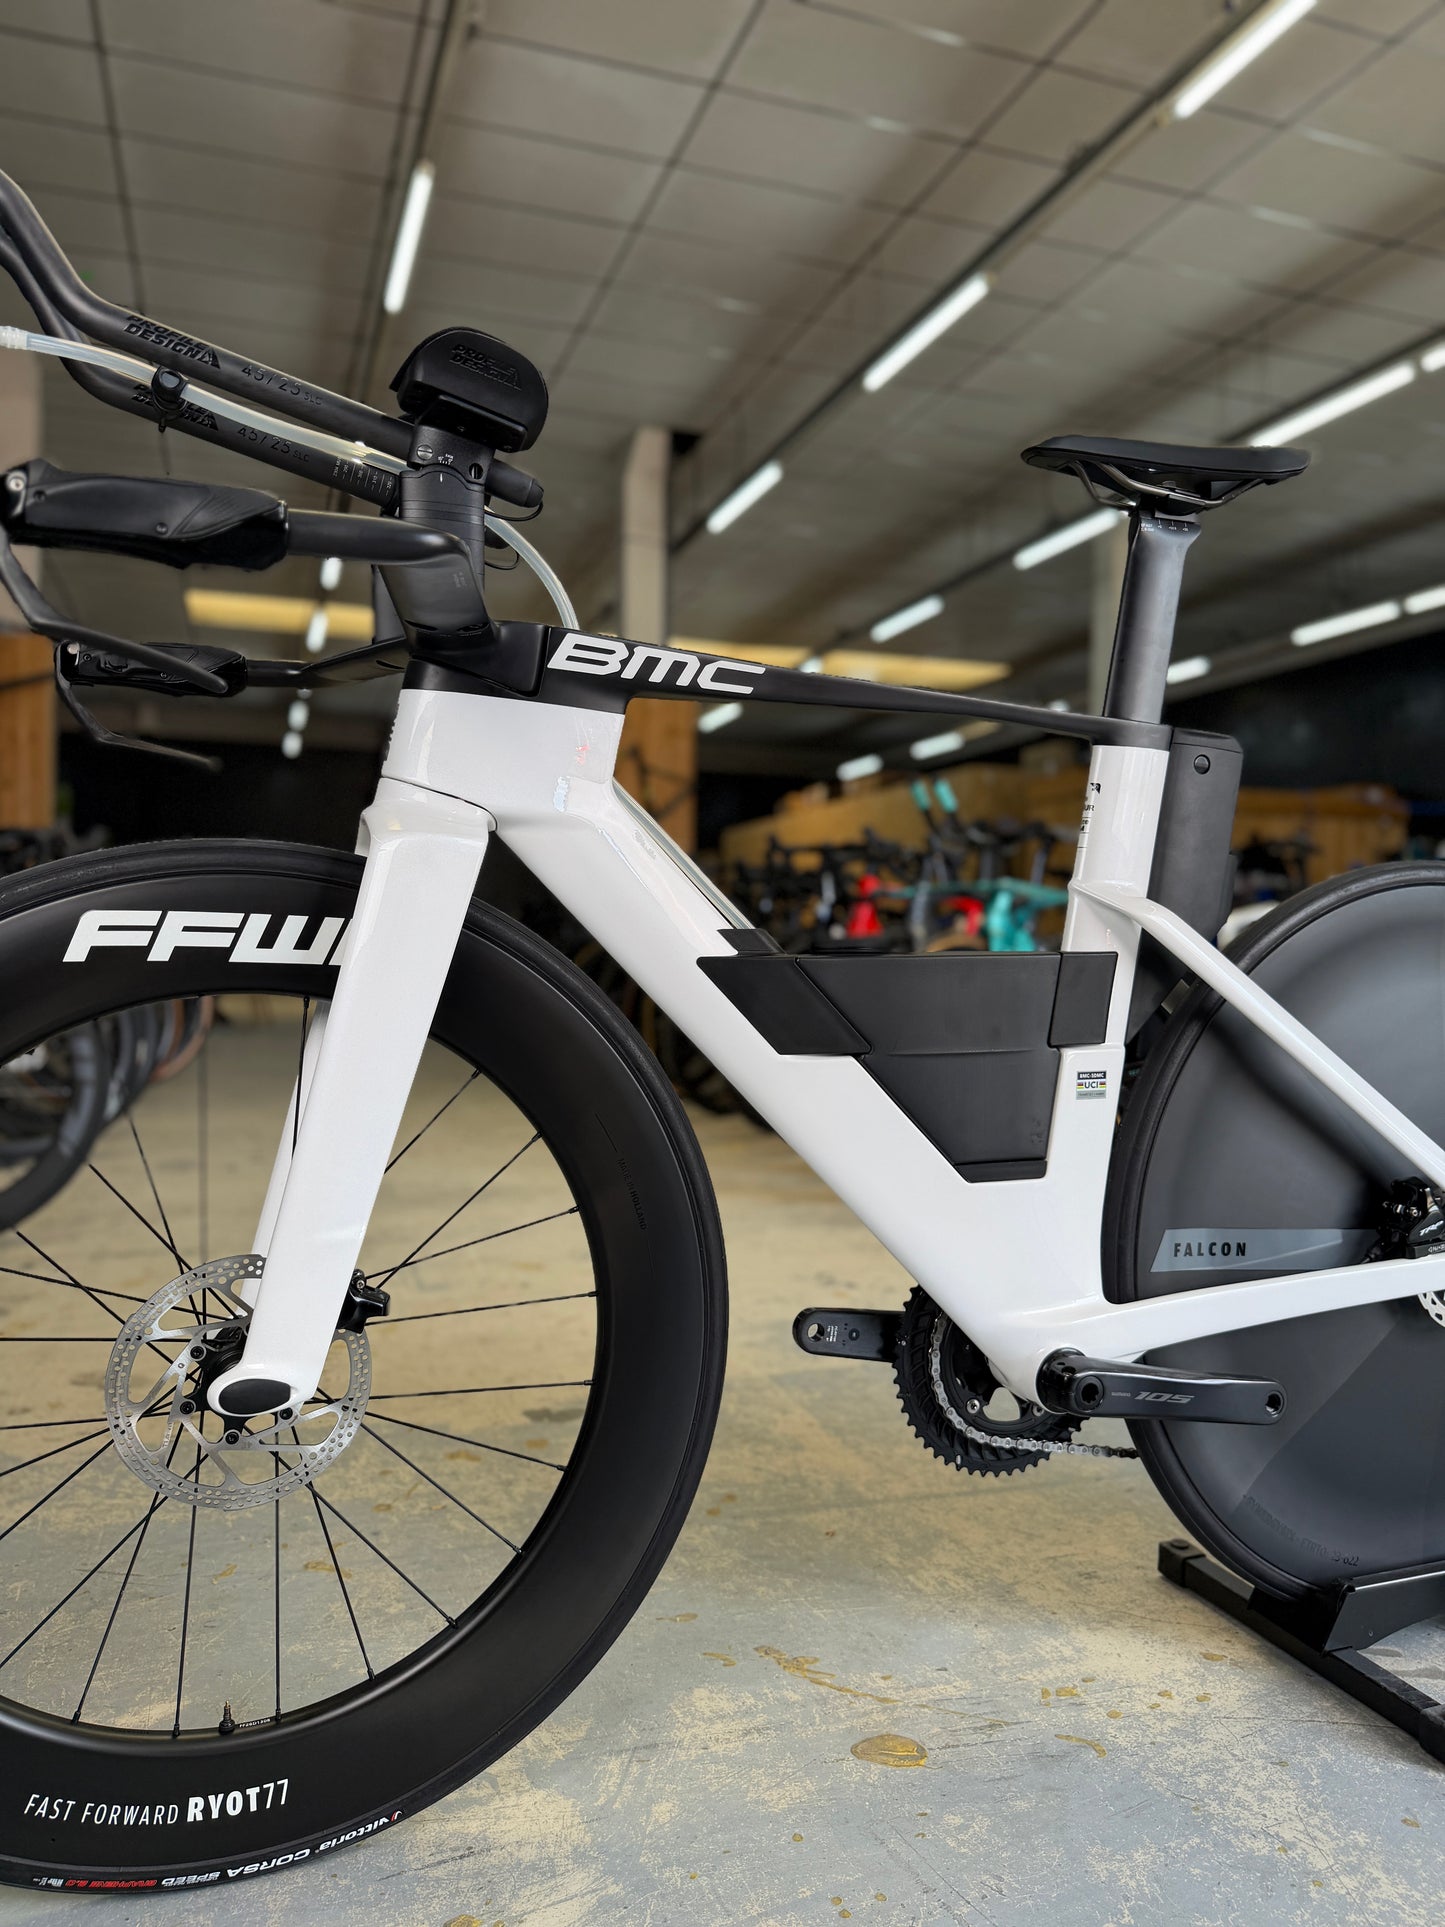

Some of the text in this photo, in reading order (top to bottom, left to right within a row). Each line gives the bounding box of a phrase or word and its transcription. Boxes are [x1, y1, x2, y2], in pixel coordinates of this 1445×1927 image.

[126, 315, 210, 350] PROFILE
[547, 632, 766, 695] BMC
[62, 910, 353, 966] FFW
[1084, 1081, 1099, 1089] UCI
[1173, 1242, 1247, 1257] FALCON
[1134, 1391, 1195, 1404] 105
[23, 1778, 290, 1826] FAST FORWARD RYOT77
[226, 1848, 311, 1878] CORSA
